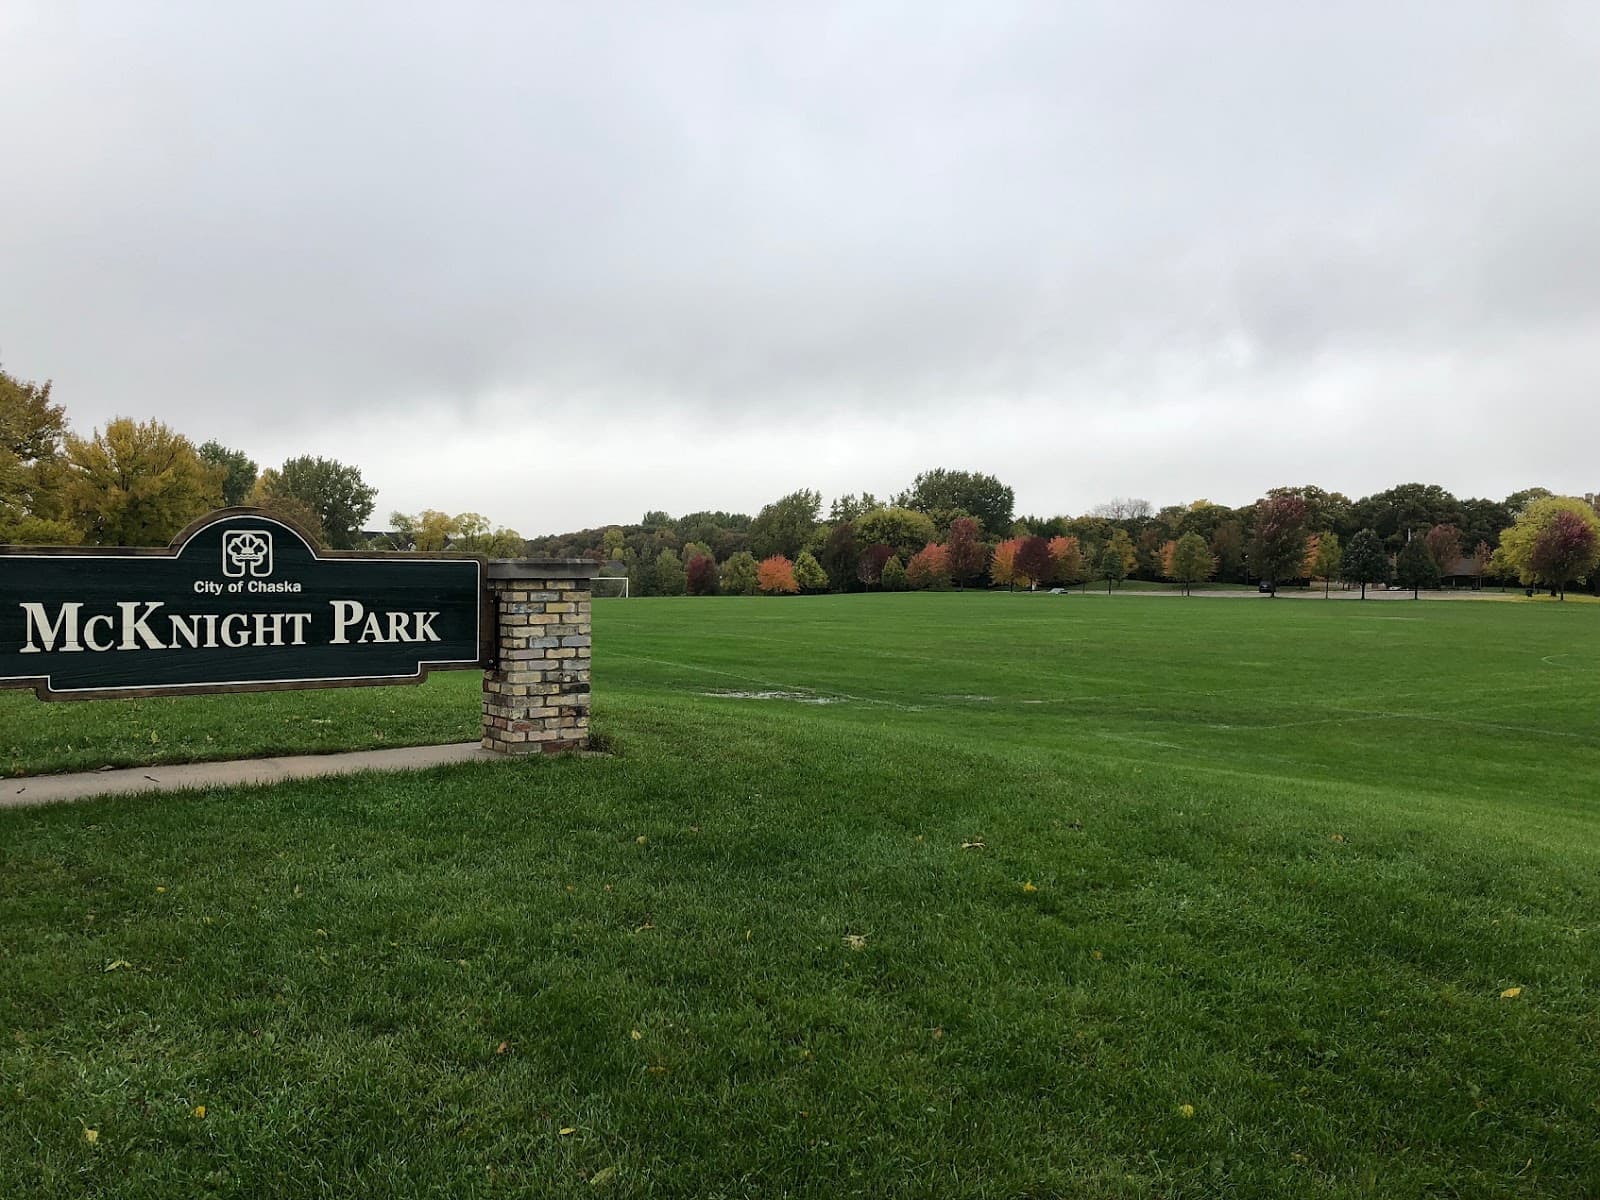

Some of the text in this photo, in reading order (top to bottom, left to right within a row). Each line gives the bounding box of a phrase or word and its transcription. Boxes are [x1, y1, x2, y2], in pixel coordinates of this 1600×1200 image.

[193, 580, 302, 595] City of Chaska
